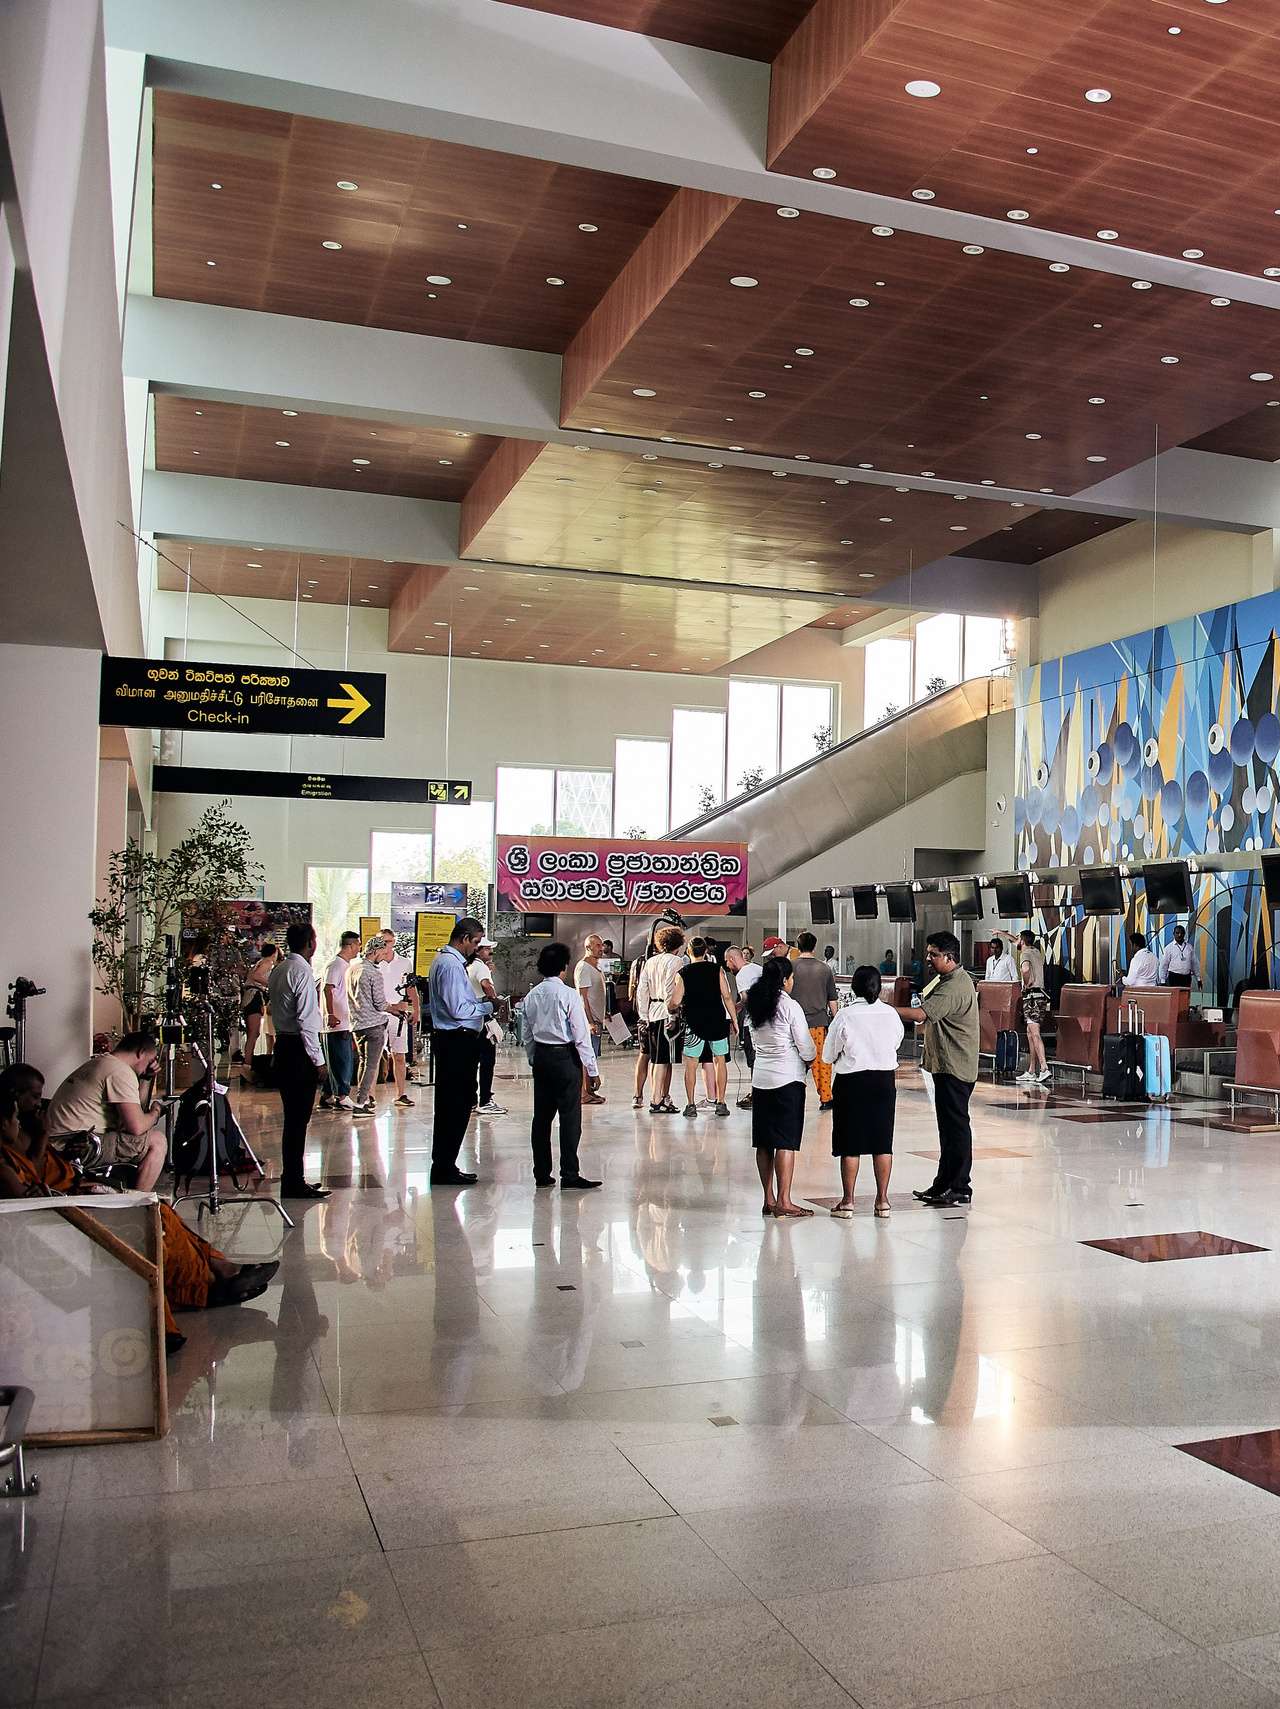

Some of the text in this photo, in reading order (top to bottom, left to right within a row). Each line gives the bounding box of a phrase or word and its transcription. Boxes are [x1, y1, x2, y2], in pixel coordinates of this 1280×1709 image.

[147, 668, 179, 681] ගුවන්
[185, 670, 235, 684] ටිකට්පත්
[116, 684, 318, 708] விமான அனுமதிச்சீட்டு பரிசோதனை
[187, 710, 249, 724] Check-in
[506, 845, 530, 874] ශ්‍රී
[538, 850, 599, 873] ලංකා
[520, 877, 728, 907] සමාජවාදී ජනරජය
